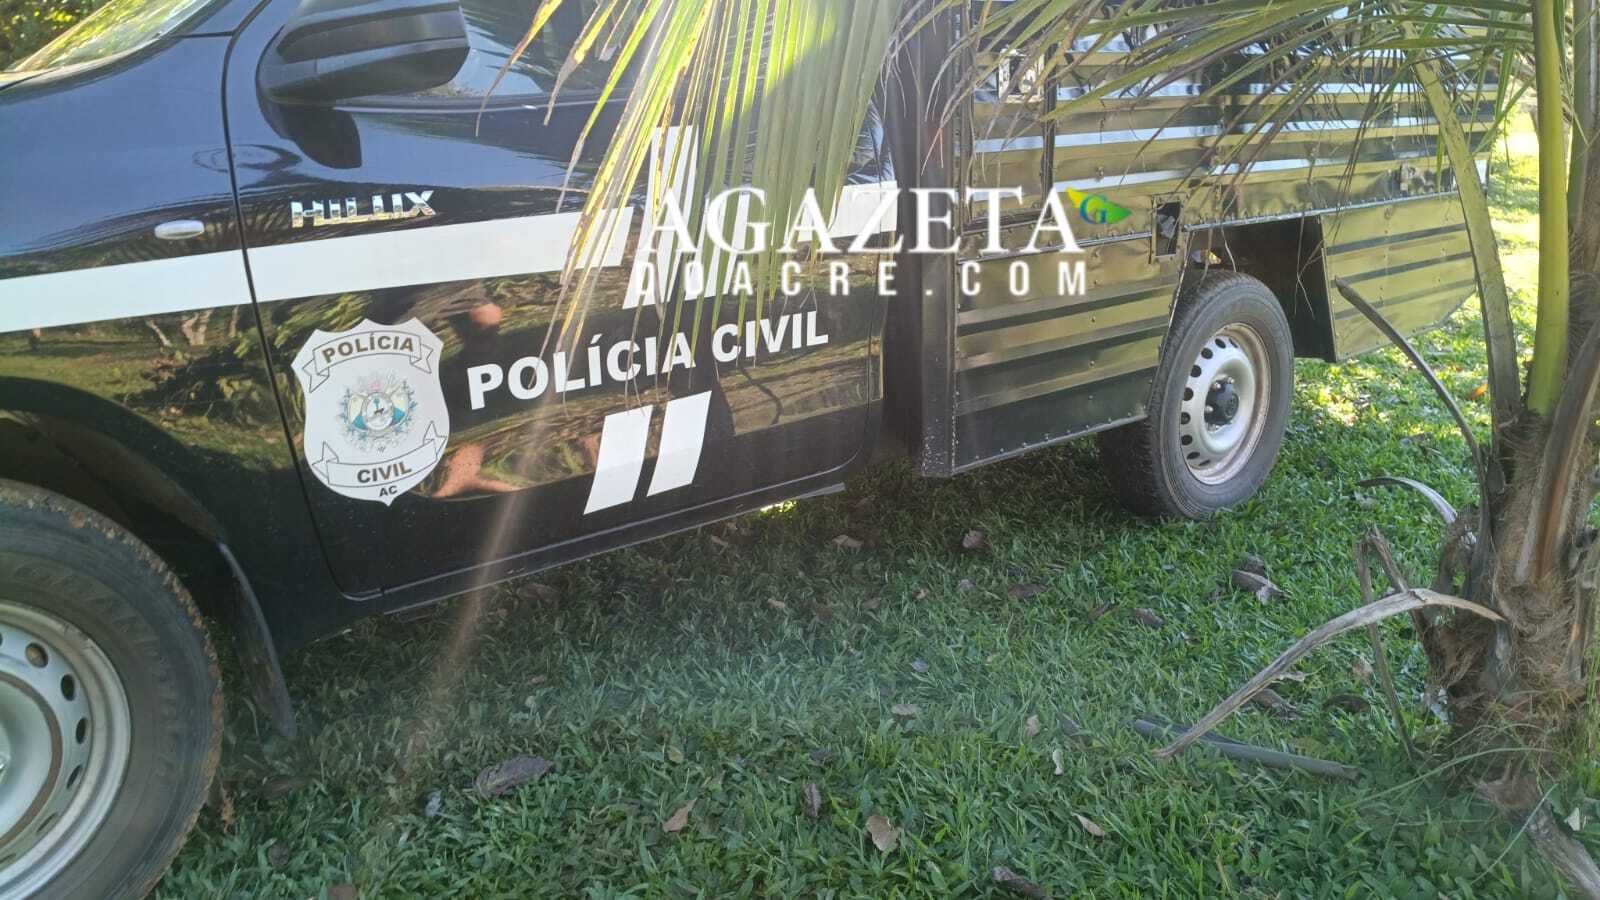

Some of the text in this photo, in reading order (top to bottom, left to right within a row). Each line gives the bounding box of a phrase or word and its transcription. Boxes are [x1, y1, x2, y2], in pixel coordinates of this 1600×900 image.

[290, 190, 436, 228] HILUX
[322, 332, 414, 364] POLÍCIA
[466, 311, 829, 410] POLÍCIA CIVIL
[357, 461, 412, 484] CIVIL
[379, 485, 398, 497] AC
